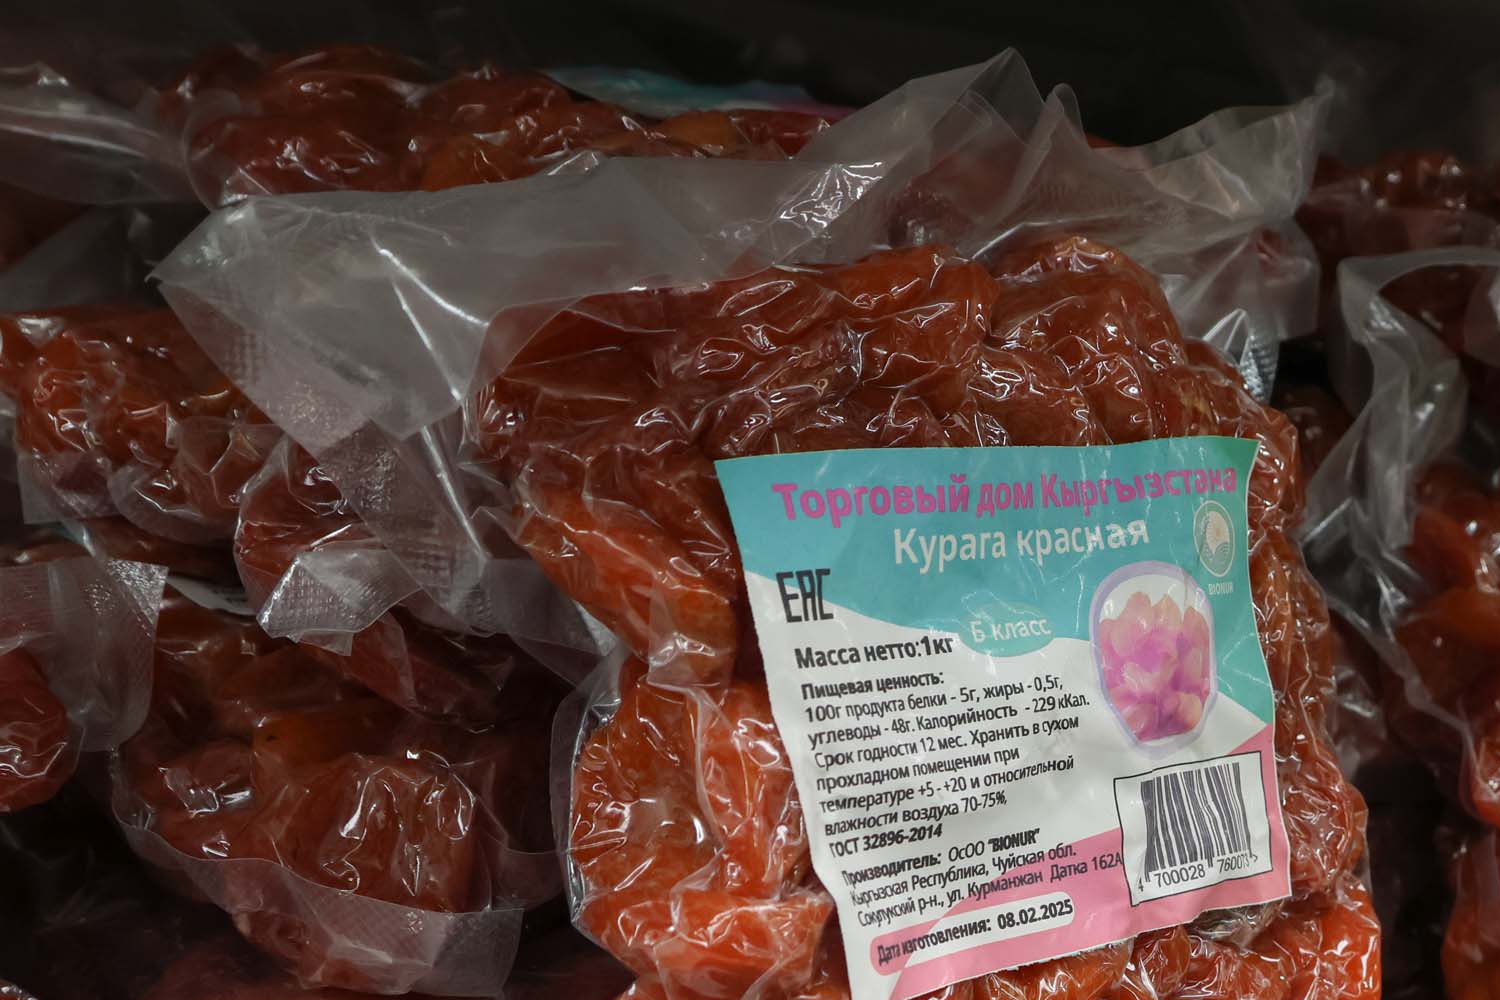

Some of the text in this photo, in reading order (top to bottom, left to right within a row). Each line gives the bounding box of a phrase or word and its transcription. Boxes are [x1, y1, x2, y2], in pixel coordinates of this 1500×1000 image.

[770, 467, 1238, 528] Торговый дом Кыргызстана
[893, 519, 1150, 575] Курага красная
[970, 618, 1052, 644] Б класс
[794, 646, 861, 669] Масса
[800, 671, 945, 701] Пищевая ценность:
[805, 704, 842, 723] 100г
[845, 698, 906, 720] продукта
[907, 693, 948, 710] белки
[959, 687, 980, 703] 5г,
[982, 681, 1025, 701] жиры
[807, 723, 882, 750] углеводы
[891, 718, 916, 734] 48г.
[915, 704, 1018, 732] Калорийность
[1032, 696, 1056, 713] 229
[1058, 693, 1090, 710] кКал.
[814, 716, 1080, 771] Срок годности 12 мес. Хранить в сухом
[816, 747, 1020, 793] прохладном помещении при
[819, 786, 915, 813] температуре
[917, 781, 934, 798] +5
[943, 776, 967, 793] +20
[970, 777, 980, 789] и
[983, 754, 1075, 787] относительной
[824, 810, 898, 837] влажности
[901, 802, 960, 822] воздуха
[829, 823, 943, 858] ГОСТ 32896-2014
[842, 852, 943, 888] Производитель:
[948, 840, 985, 863] ОсОО
[850, 842, 1077, 908] Кыргызская Республика, Чуйская обл.
[946, 888, 965, 908] ул.
[967, 871, 1044, 901] Курманжан
[1050, 860, 1089, 883] Датка
[1153, 863, 1206, 888] 700028
[877, 898, 1074, 966] Дата изготовления: 08.02.2025
